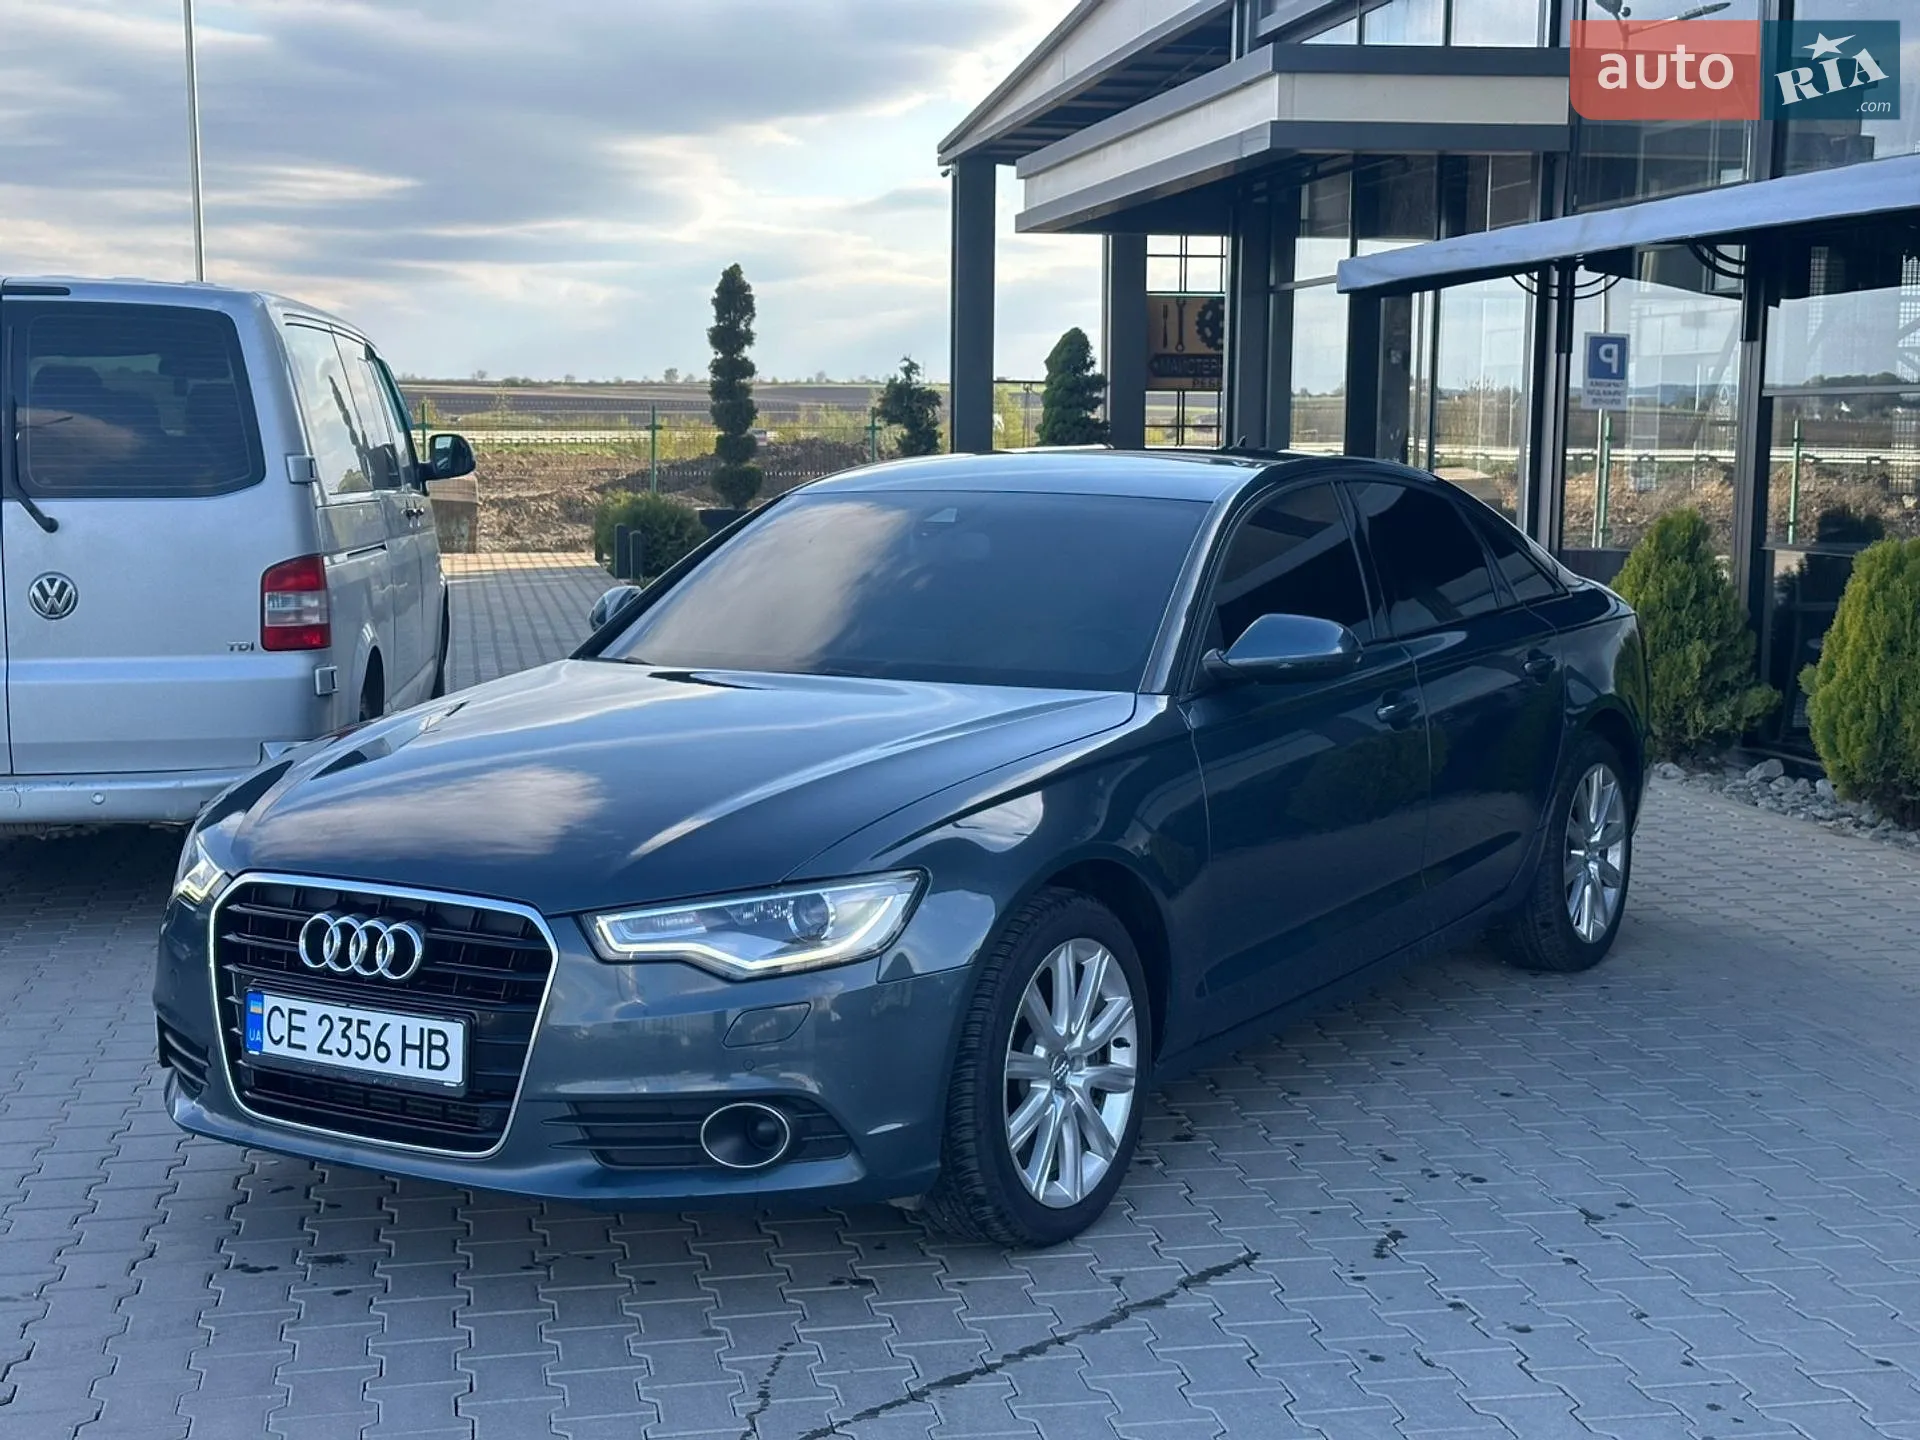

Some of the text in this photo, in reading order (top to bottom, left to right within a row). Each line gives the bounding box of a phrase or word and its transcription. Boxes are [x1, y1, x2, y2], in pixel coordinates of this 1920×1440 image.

[227, 641, 255, 652] TDI
[249, 1028, 262, 1042] UA
[266, 1005, 451, 1072] CE 2356 HB
